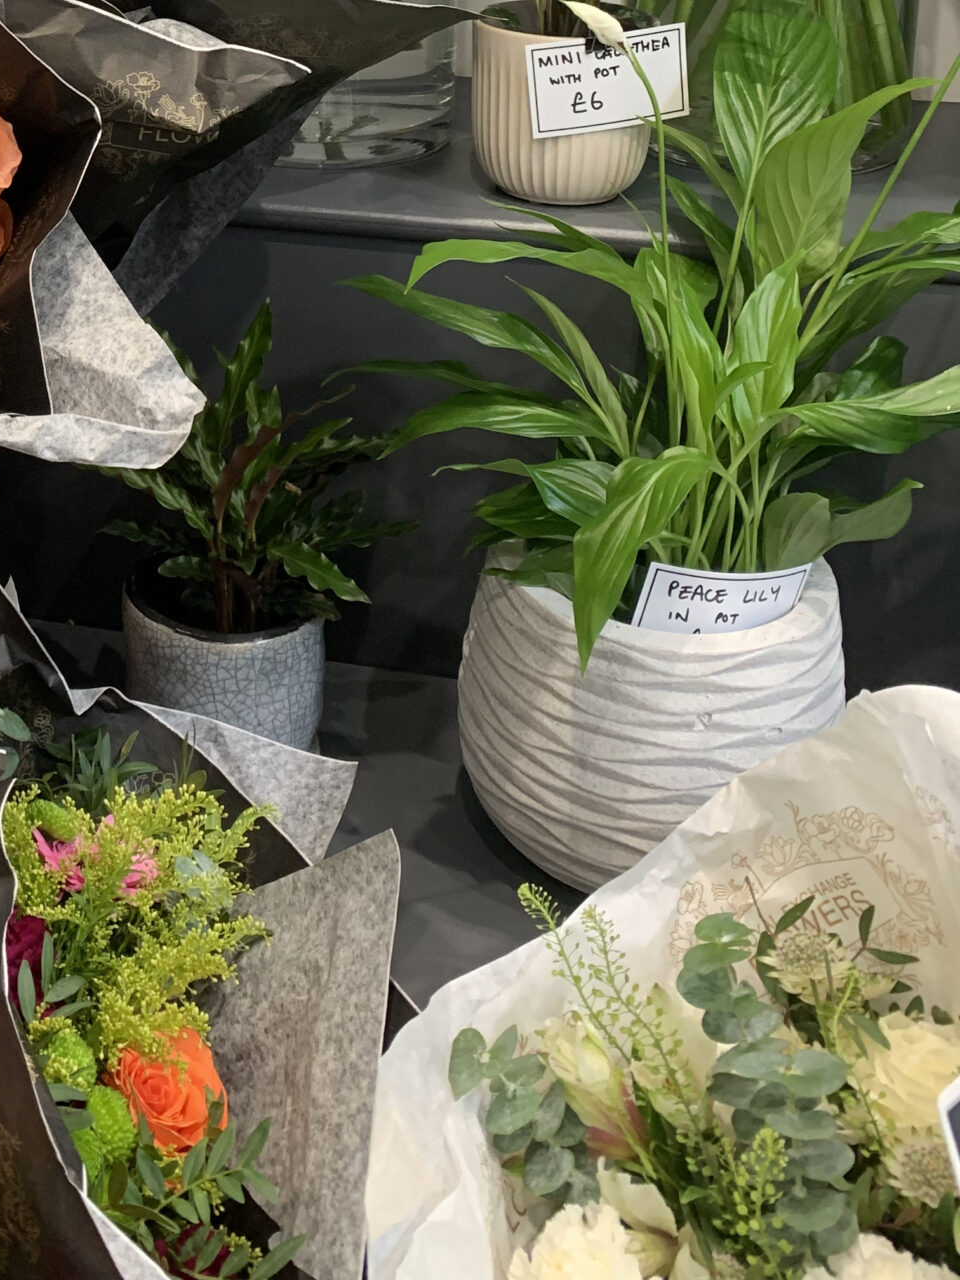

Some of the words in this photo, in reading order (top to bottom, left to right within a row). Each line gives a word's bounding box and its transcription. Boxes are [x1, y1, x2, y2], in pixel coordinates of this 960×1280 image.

[538, 51, 582, 68] MINI
[594, 36, 670, 60] CALTHEA
[549, 73, 582, 86] WITH
[593, 65, 620, 79] POT
[571, 91, 604, 114] £6
[667, 580, 729, 604] PEACE
[742, 585, 782, 604] LILY
[668, 608, 690, 623] IN
[714, 612, 740, 625] POT
